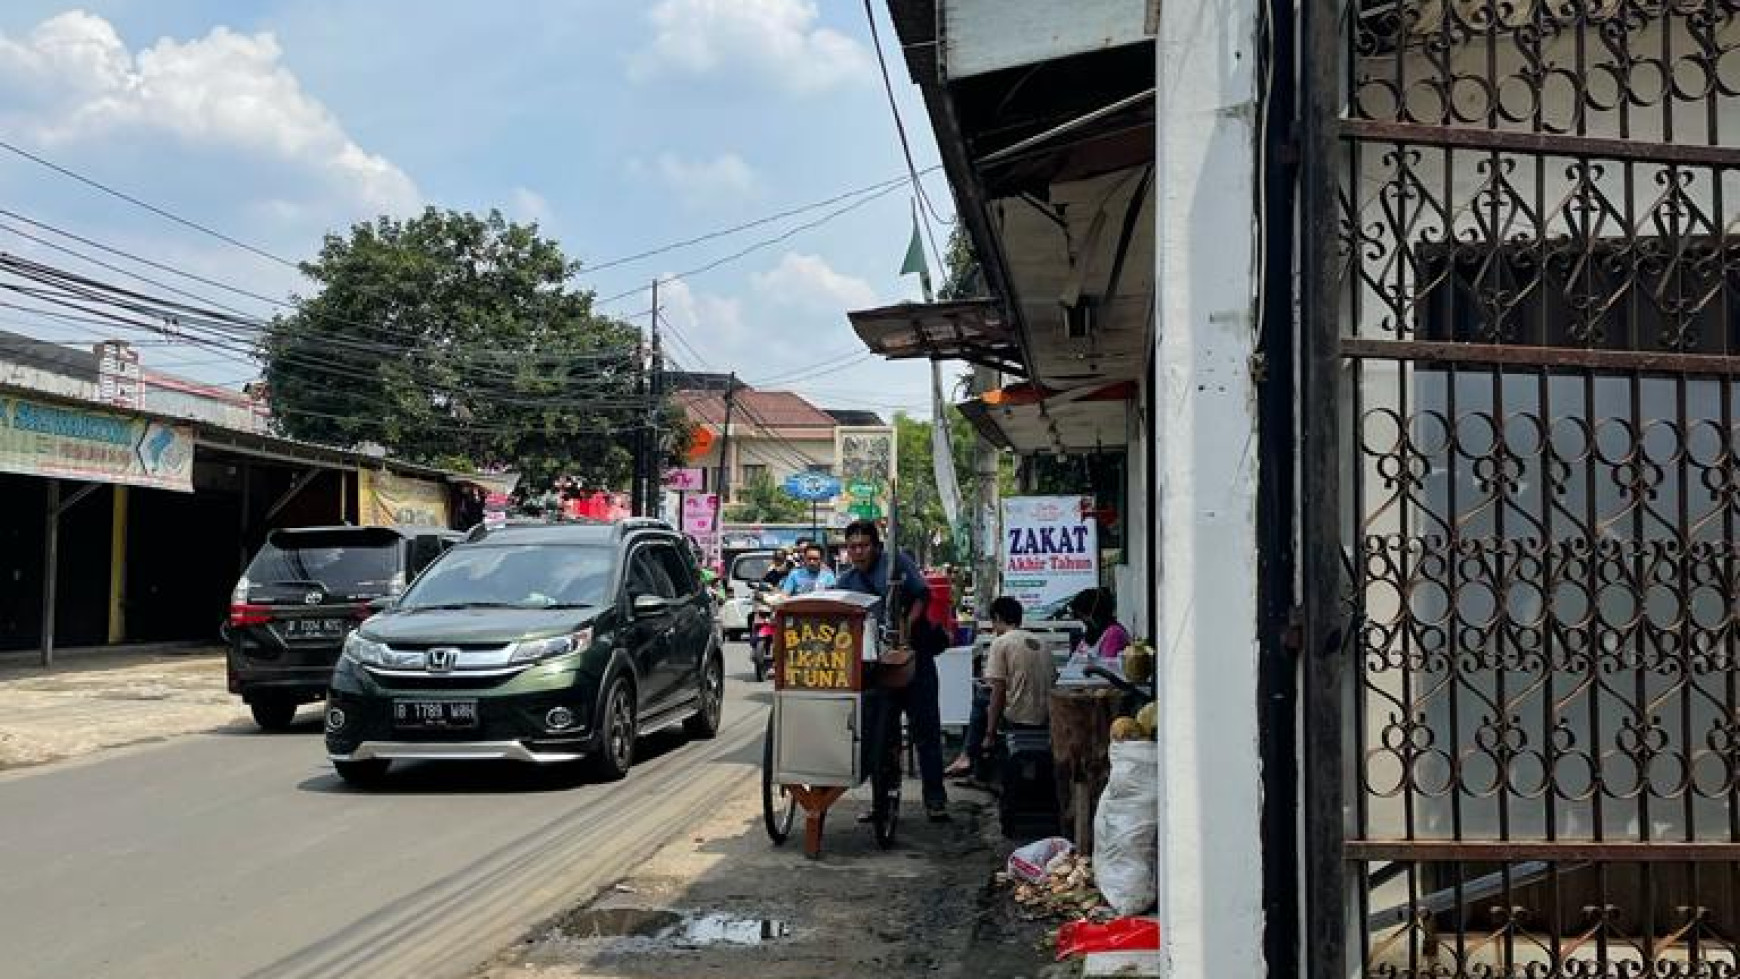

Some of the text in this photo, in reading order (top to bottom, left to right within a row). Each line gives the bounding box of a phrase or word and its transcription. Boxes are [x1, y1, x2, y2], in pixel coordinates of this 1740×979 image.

[1008, 525, 1088, 554] ZAKAT
[1008, 555, 1093, 571] Akhir Tahun
[784, 622, 853, 650] BASO
[786, 650, 846, 669] IKAN
[786, 670, 850, 688] TUNA
